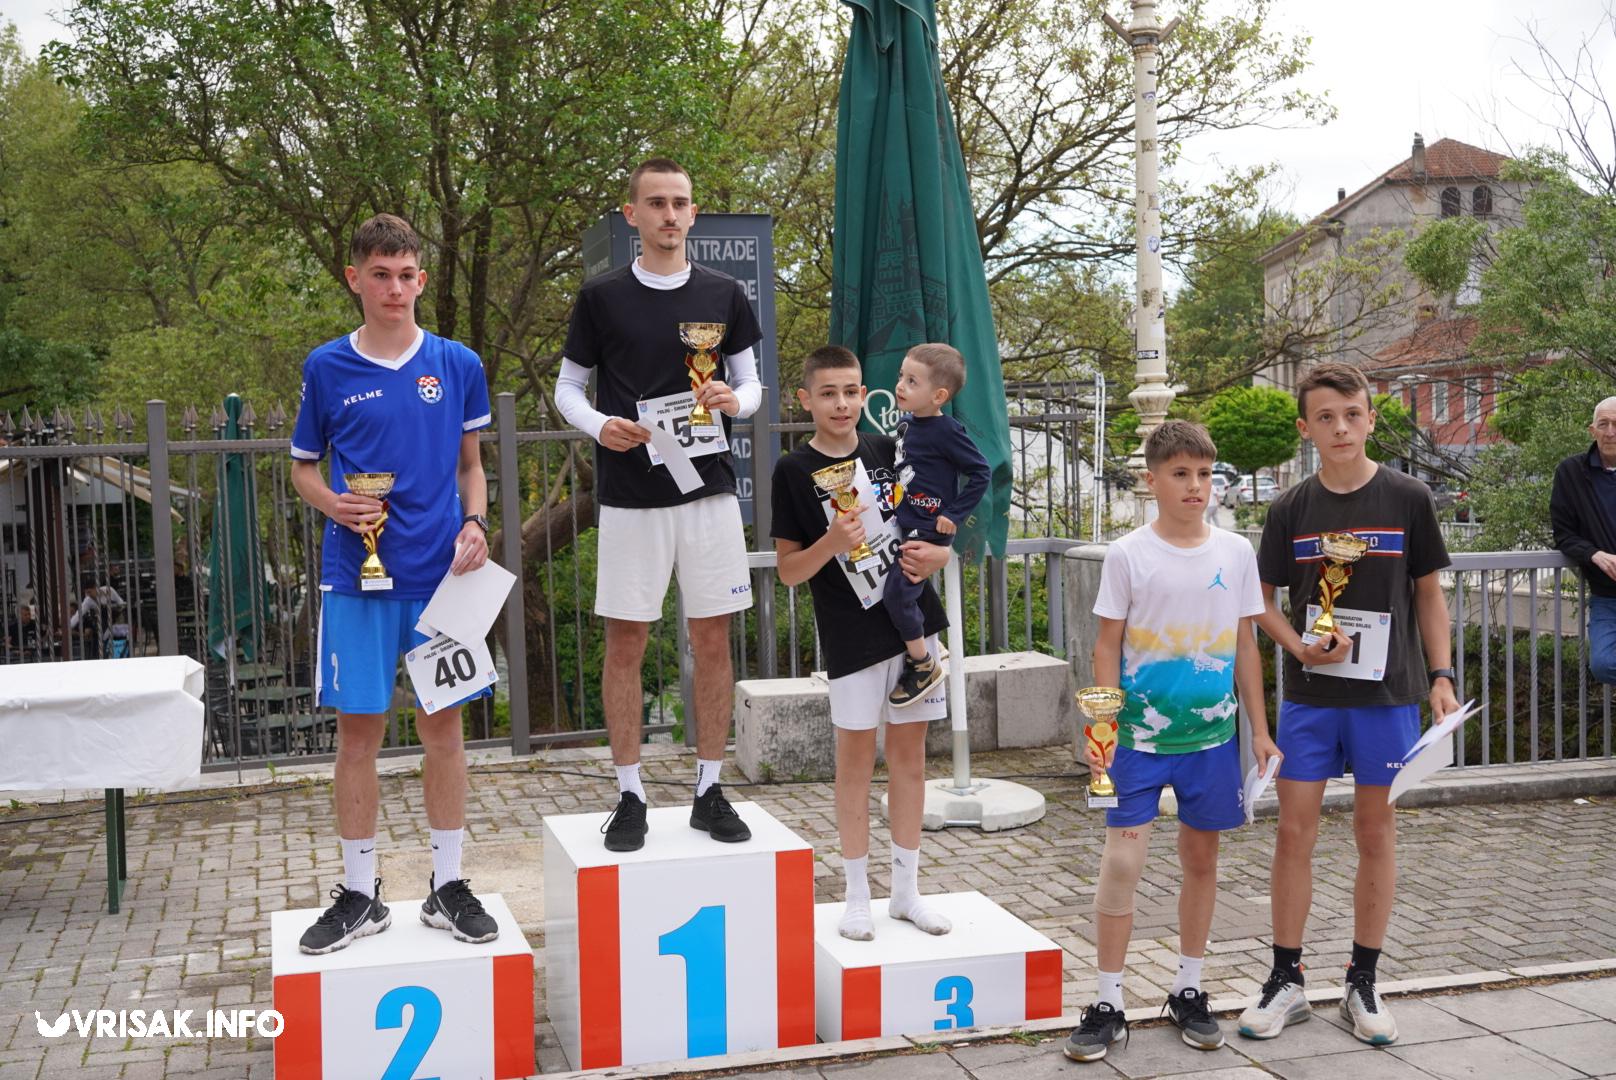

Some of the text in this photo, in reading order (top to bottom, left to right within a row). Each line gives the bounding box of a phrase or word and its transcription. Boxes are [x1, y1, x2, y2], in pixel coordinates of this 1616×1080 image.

[344, 389, 384, 406] KELME
[435, 648, 476, 689] 40
[658, 905, 727, 1059] 1
[934, 975, 974, 1030] 3
[375, 985, 443, 1080] 2
